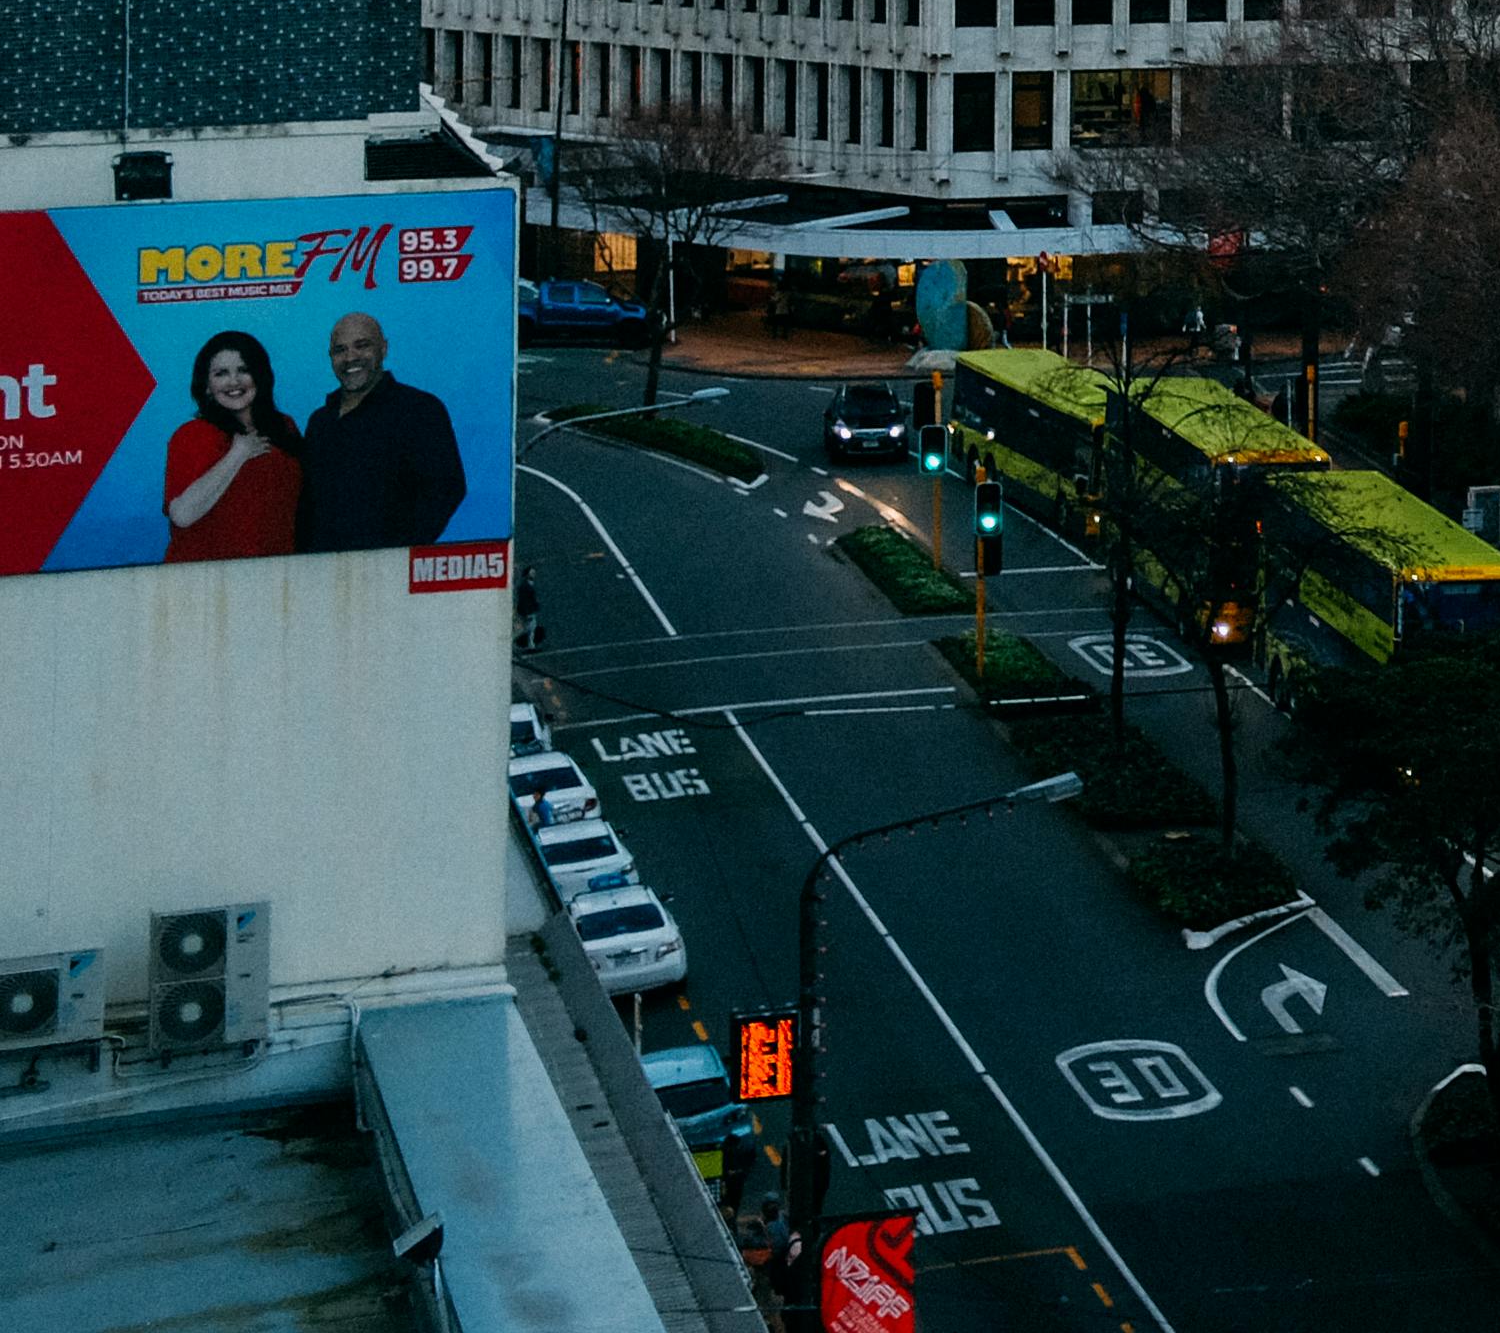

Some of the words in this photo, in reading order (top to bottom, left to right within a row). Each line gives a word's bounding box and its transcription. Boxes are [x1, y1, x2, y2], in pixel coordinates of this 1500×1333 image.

[402, 229, 459, 252] 95.3
[138, 241, 298, 284] MORE
[295, 223, 393, 290] FM
[402, 258, 459, 280] 99.7
[142, 289, 194, 302] TODAY'S
[196, 287, 226, 300] BEST
[229, 285, 268, 297] MUSIC
[269, 283, 293, 295] MIX
[9, 449, 83, 469] 5.30AM
[412, 553, 505, 583] MEDIA5
[590, 729, 698, 762] LANE
[622, 768, 711, 802] BUS
[1087, 1056, 1190, 1104] 30
[826, 1110, 971, 1168] LANE
